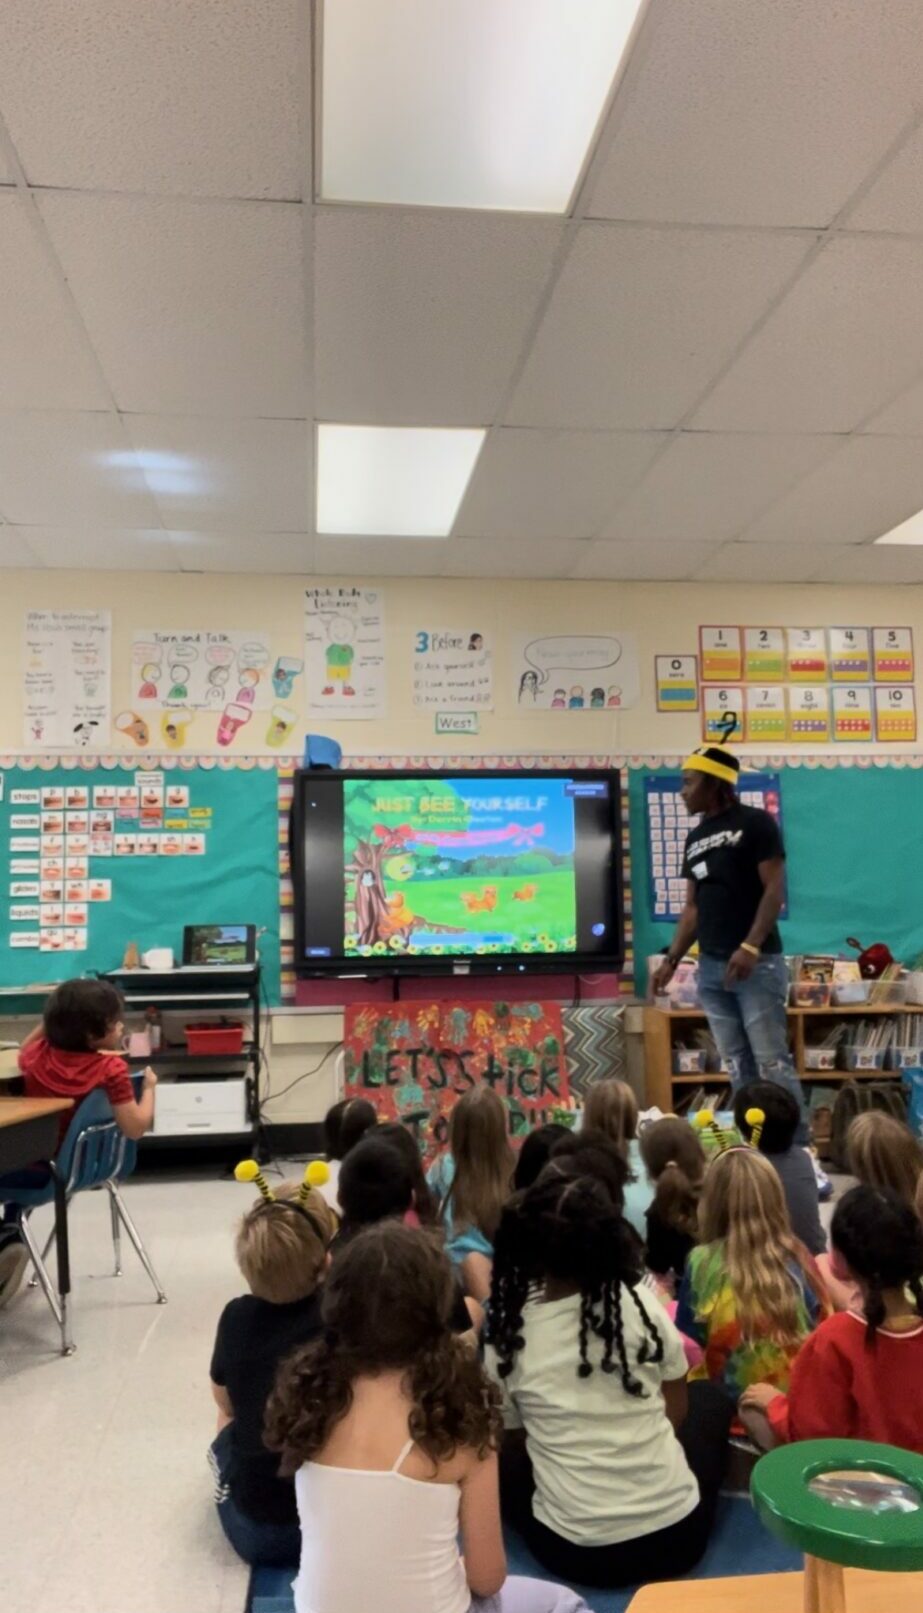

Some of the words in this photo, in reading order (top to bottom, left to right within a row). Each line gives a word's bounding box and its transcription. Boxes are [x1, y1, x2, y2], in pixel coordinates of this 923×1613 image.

[152, 632, 178, 644] Turn
[180, 633, 201, 643] and
[205, 633, 231, 644] Talk
[717, 629, 724, 641] 1
[759, 630, 768, 642] 2
[801, 629, 811, 641] 3
[844, 630, 854, 642] 4
[888, 631, 897, 642] 5
[414, 631, 430, 653] 3
[431, 632, 463, 652] Before
[671, 658, 683, 671] 0
[718, 690, 729, 702] 6
[761, 690, 769, 702] 7
[803, 691, 814, 702] 8
[846, 690, 857, 701] 9
[888, 690, 904, 702] 10
[439, 717, 473, 729] West
[373, 797, 414, 812] JUST
[419, 797, 454, 813] BEE
[461, 797, 548, 811] YOURSELF
